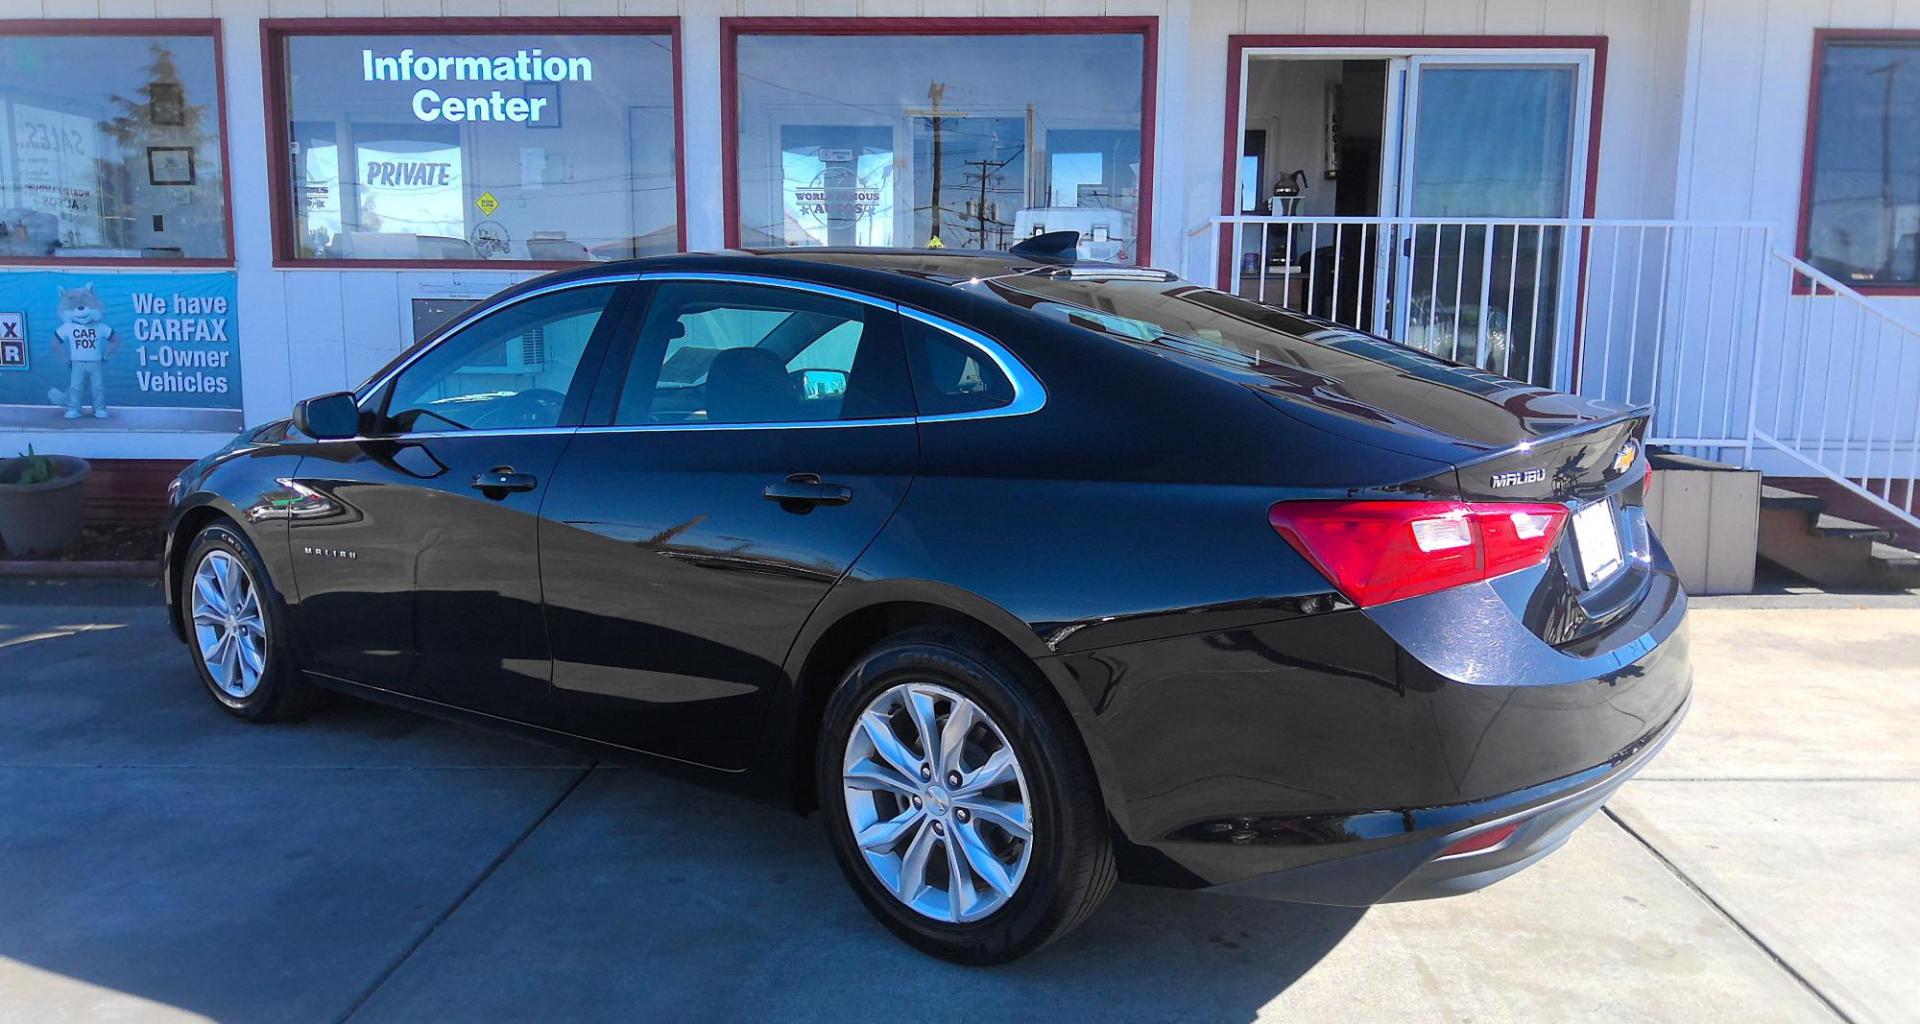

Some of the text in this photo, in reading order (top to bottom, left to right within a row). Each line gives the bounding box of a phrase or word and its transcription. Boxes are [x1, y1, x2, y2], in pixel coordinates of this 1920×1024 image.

[363, 49, 593, 81] Information
[412, 88, 547, 122] Center
[367, 161, 451, 187] PRIVATE
[795, 192, 832, 201] WORL
[132, 293, 227, 314] We have
[72, 329, 97, 339] CAR
[134, 318, 227, 341] CARFAX
[75, 339, 97, 350] FOX
[136, 346, 229, 368] 1-Owner
[136, 371, 228, 393] Vehicles
[1491, 469, 1546, 488] MALIBU
[304, 547, 357, 559] MALIBU
